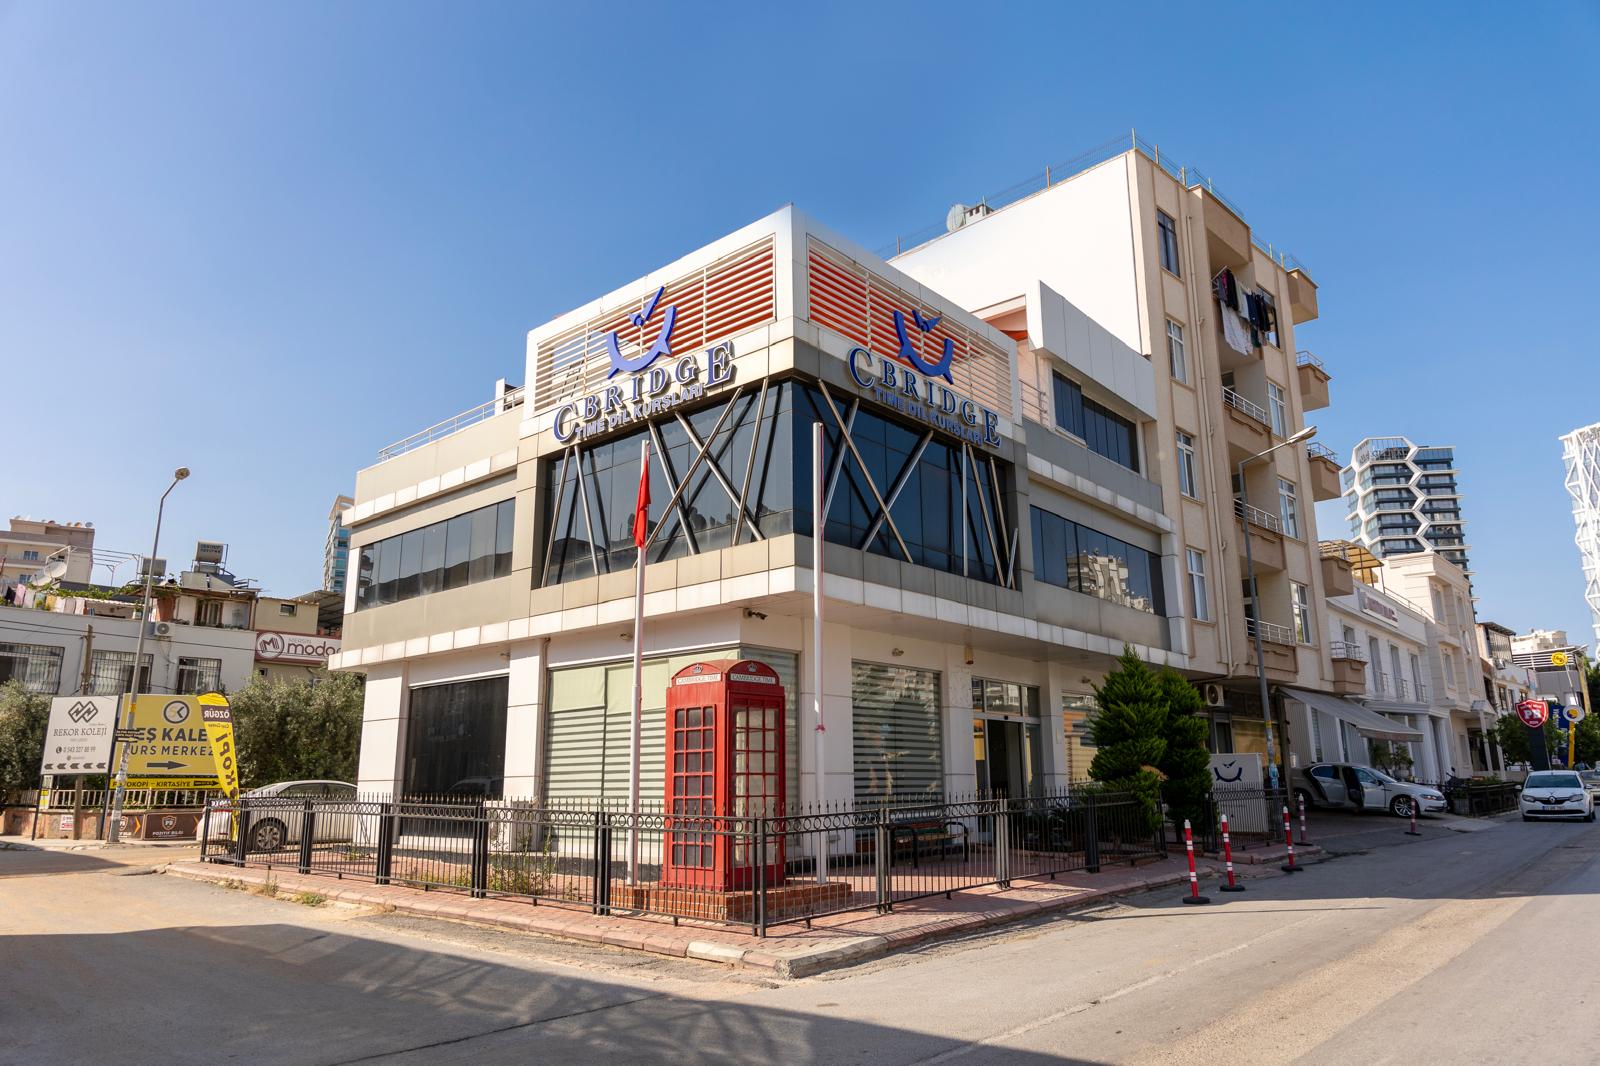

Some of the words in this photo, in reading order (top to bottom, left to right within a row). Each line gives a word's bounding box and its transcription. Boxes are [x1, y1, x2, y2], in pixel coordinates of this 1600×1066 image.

[553, 340, 736, 442] CBRIDGE
[848, 347, 1001, 448] CBRIDGE
[875, 387, 905, 411] TIME
[575, 418, 605, 440] TIME
[53, 728, 79, 737] REKOR
[136, 727, 157, 743] EŞ
[161, 728, 207, 742] KALE
